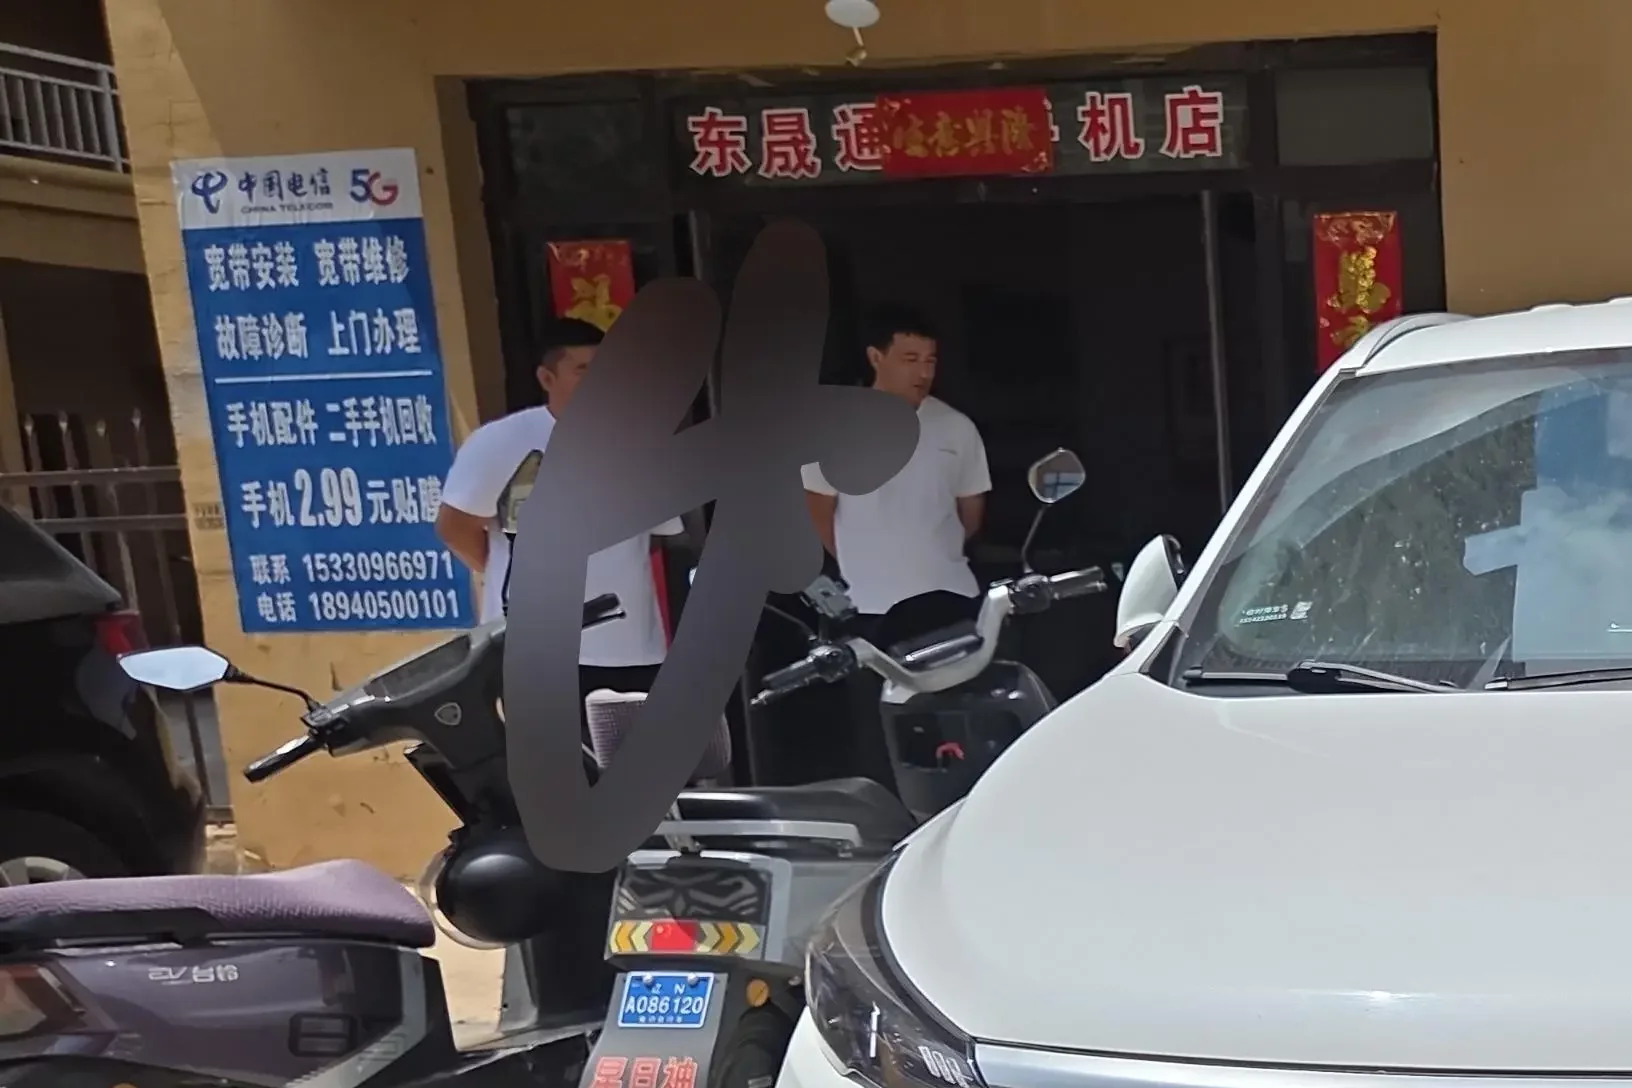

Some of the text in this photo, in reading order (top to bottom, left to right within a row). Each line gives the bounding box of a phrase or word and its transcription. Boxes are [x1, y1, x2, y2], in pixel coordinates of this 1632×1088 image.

[689, 85, 1225, 179] 东晟通机店
[238, 168, 331, 203] 中国电信
[349, 168, 399, 206] 5G
[204, 236, 409, 293] 宽带安装 宽带维修
[215, 307, 422, 361] 故障诊断 上门办理
[226, 395, 437, 448] 手机配件 二手手机回收
[249, 550, 454, 585] 联系 15330966971
[257, 589, 460, 623] 电话 18940500101
[625, 995, 704, 1014] A086120
[674, 983, 686, 995] N
